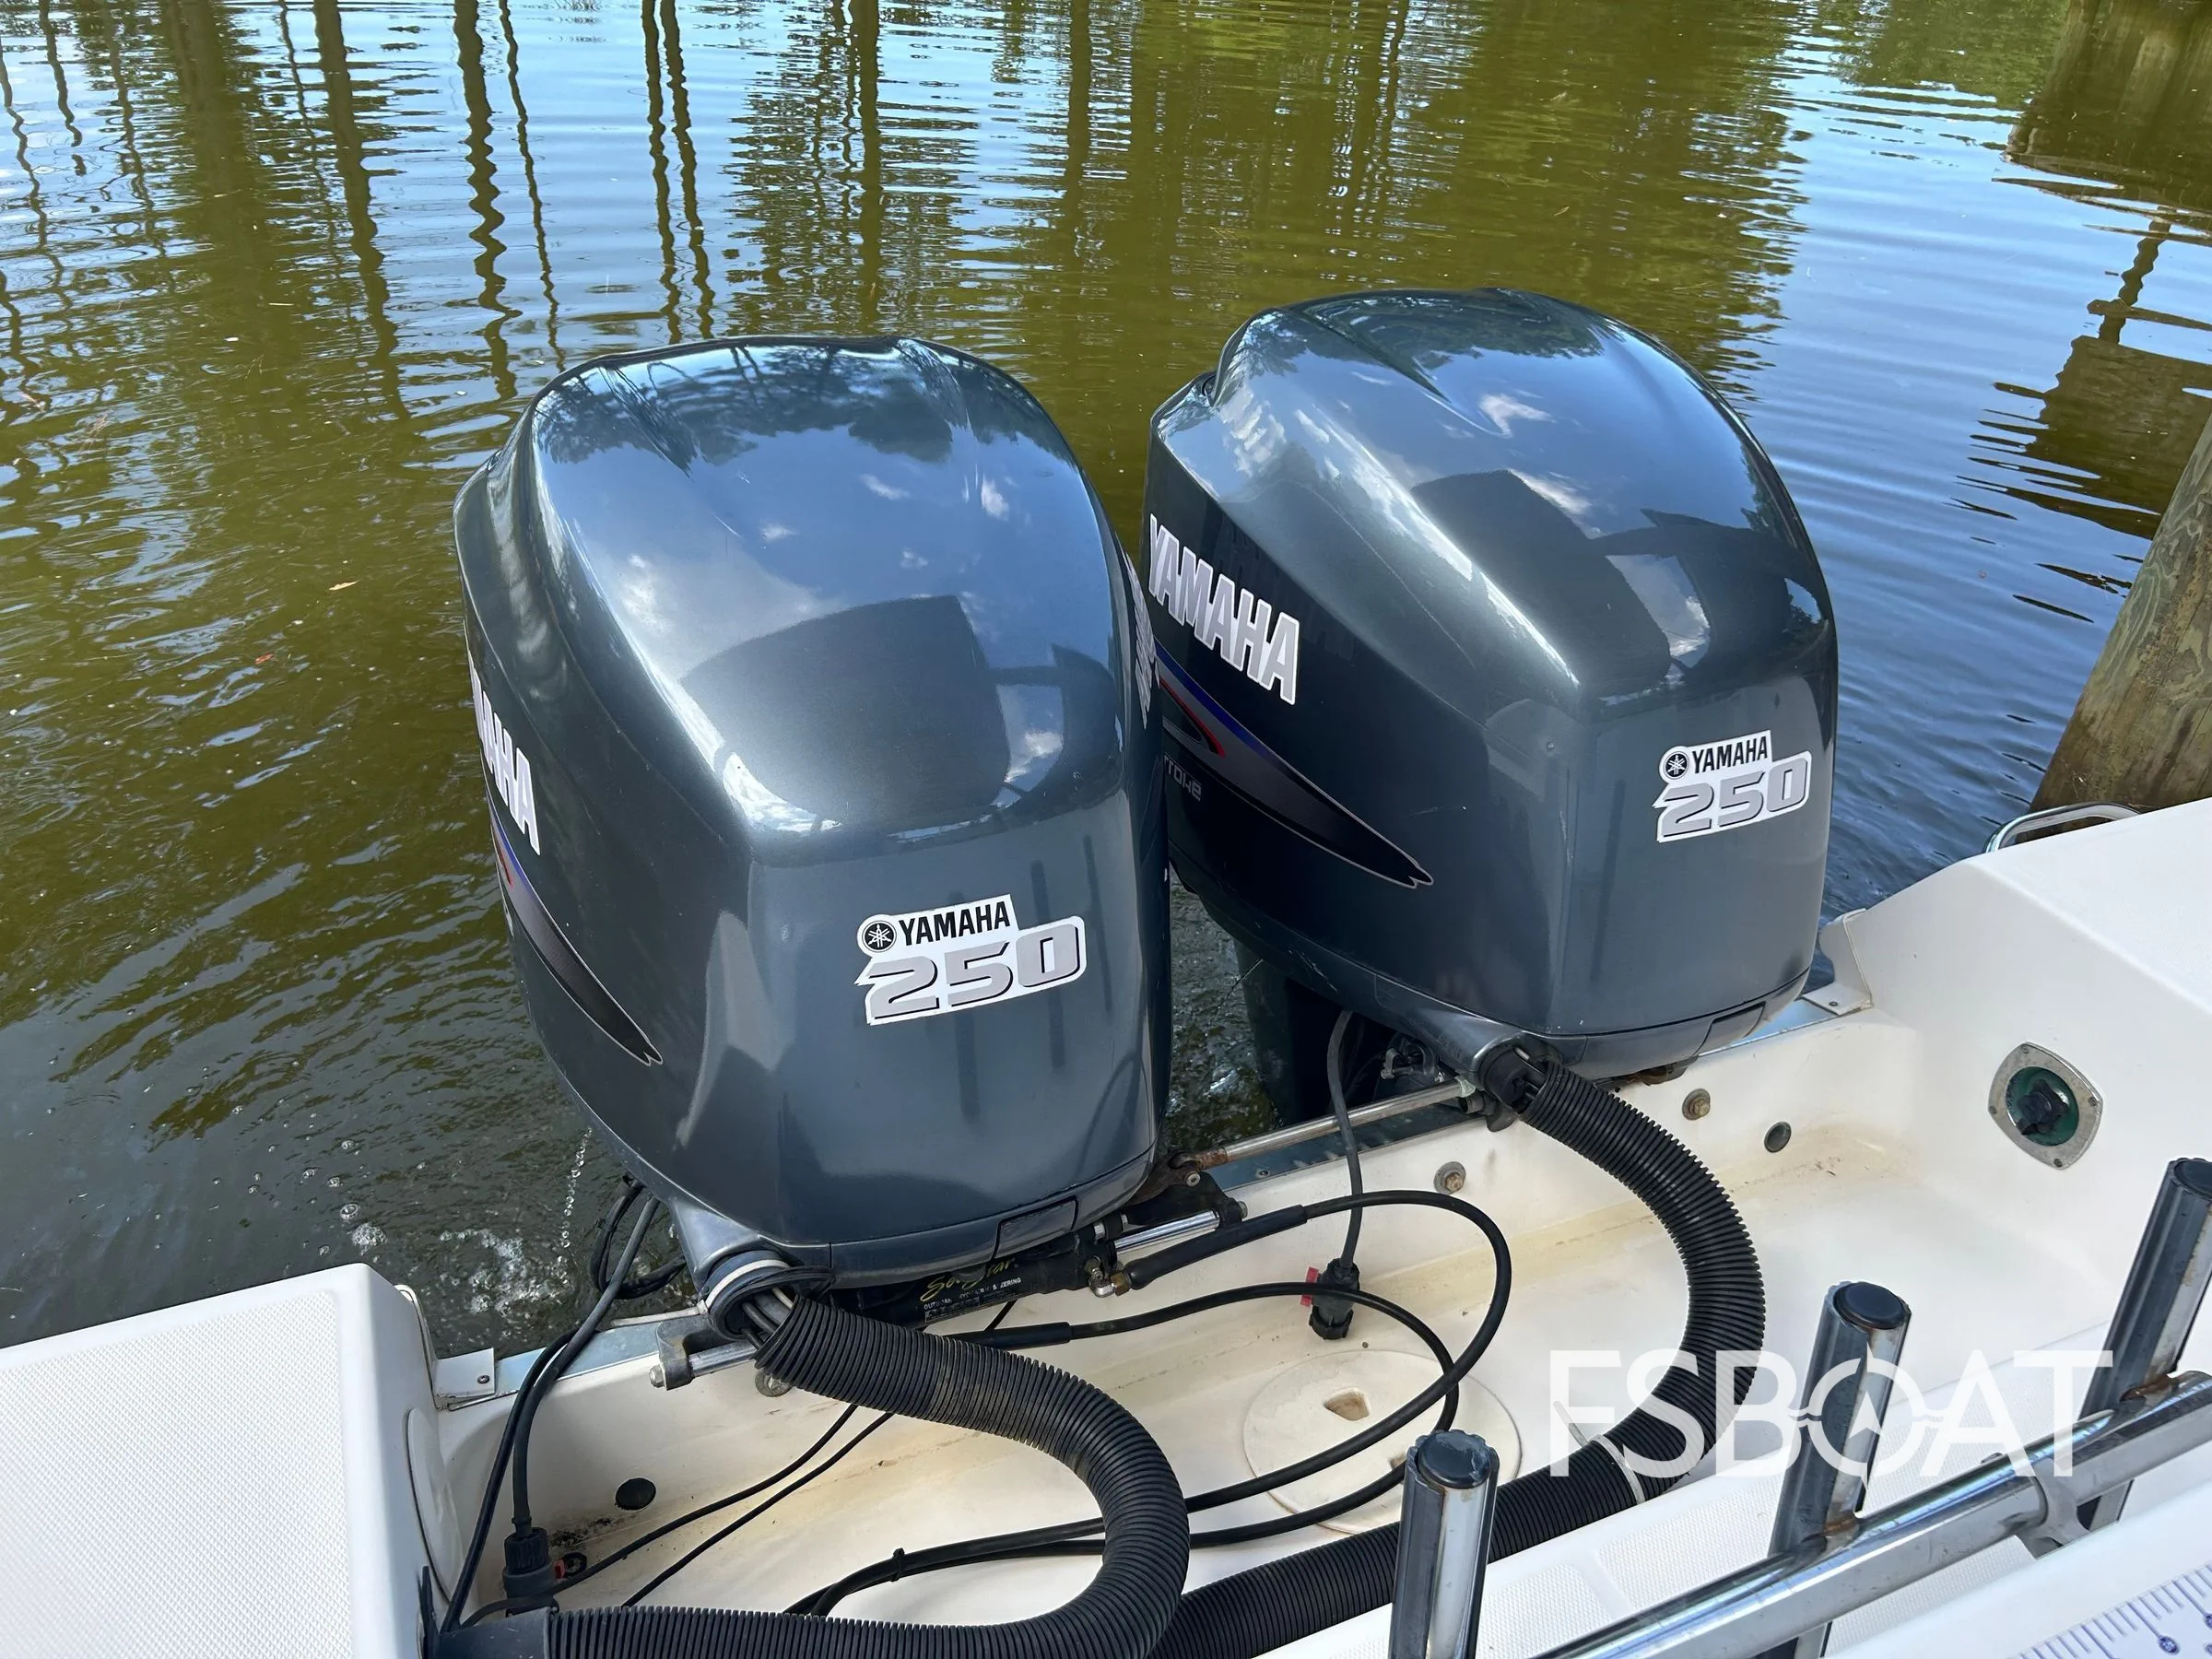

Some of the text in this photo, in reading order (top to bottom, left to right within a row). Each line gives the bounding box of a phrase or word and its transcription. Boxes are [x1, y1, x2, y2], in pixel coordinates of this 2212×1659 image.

[1148, 513, 1300, 705] YAMAHA
[1691, 735, 1768, 773] YAMAHA
[1663, 758, 1807, 838] 250
[899, 900, 1010, 947] YAMAHA
[867, 924, 1080, 1019] 250
